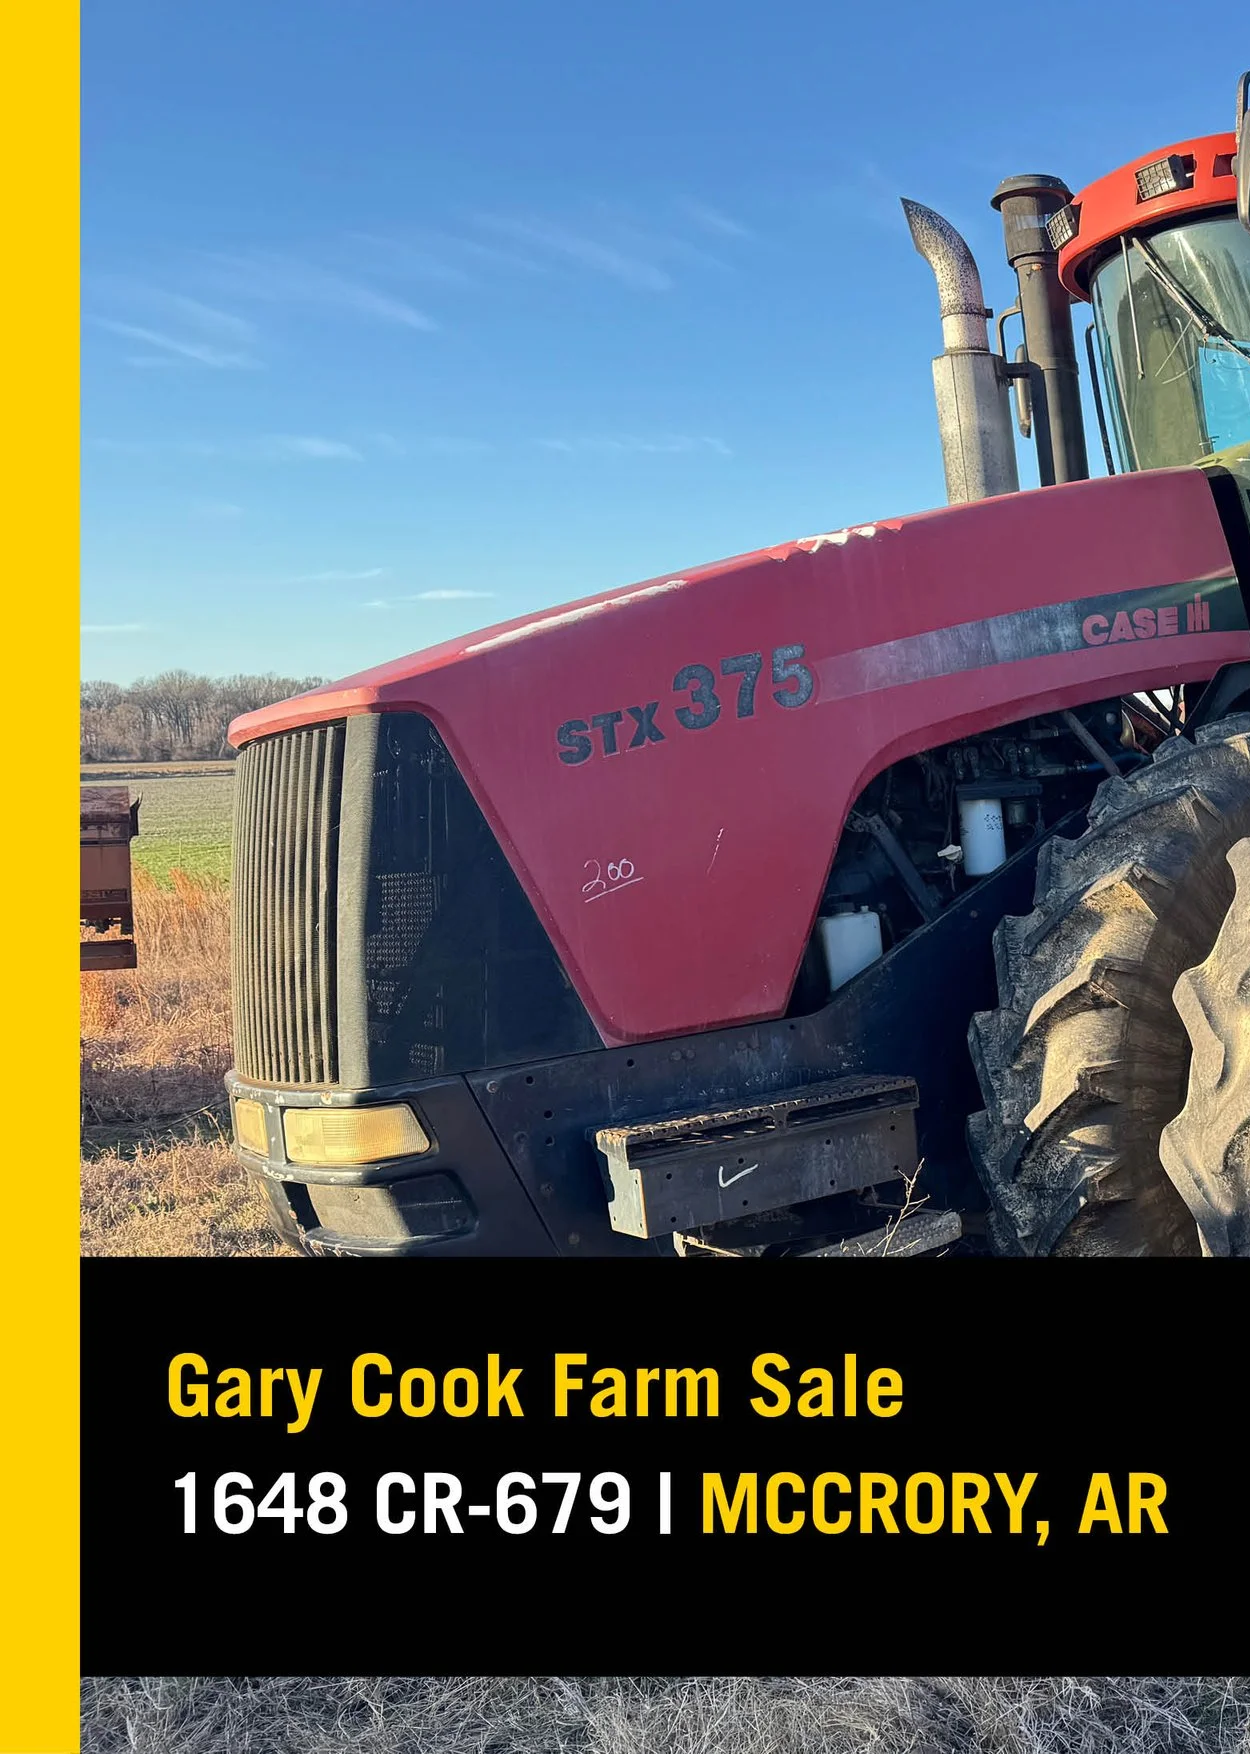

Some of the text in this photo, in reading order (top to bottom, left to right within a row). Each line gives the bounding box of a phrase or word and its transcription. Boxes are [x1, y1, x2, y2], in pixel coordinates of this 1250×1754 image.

[1082, 606, 1179, 646] CASE
[556, 643, 815, 766] STX 375
[582, 858, 635, 893] 200
